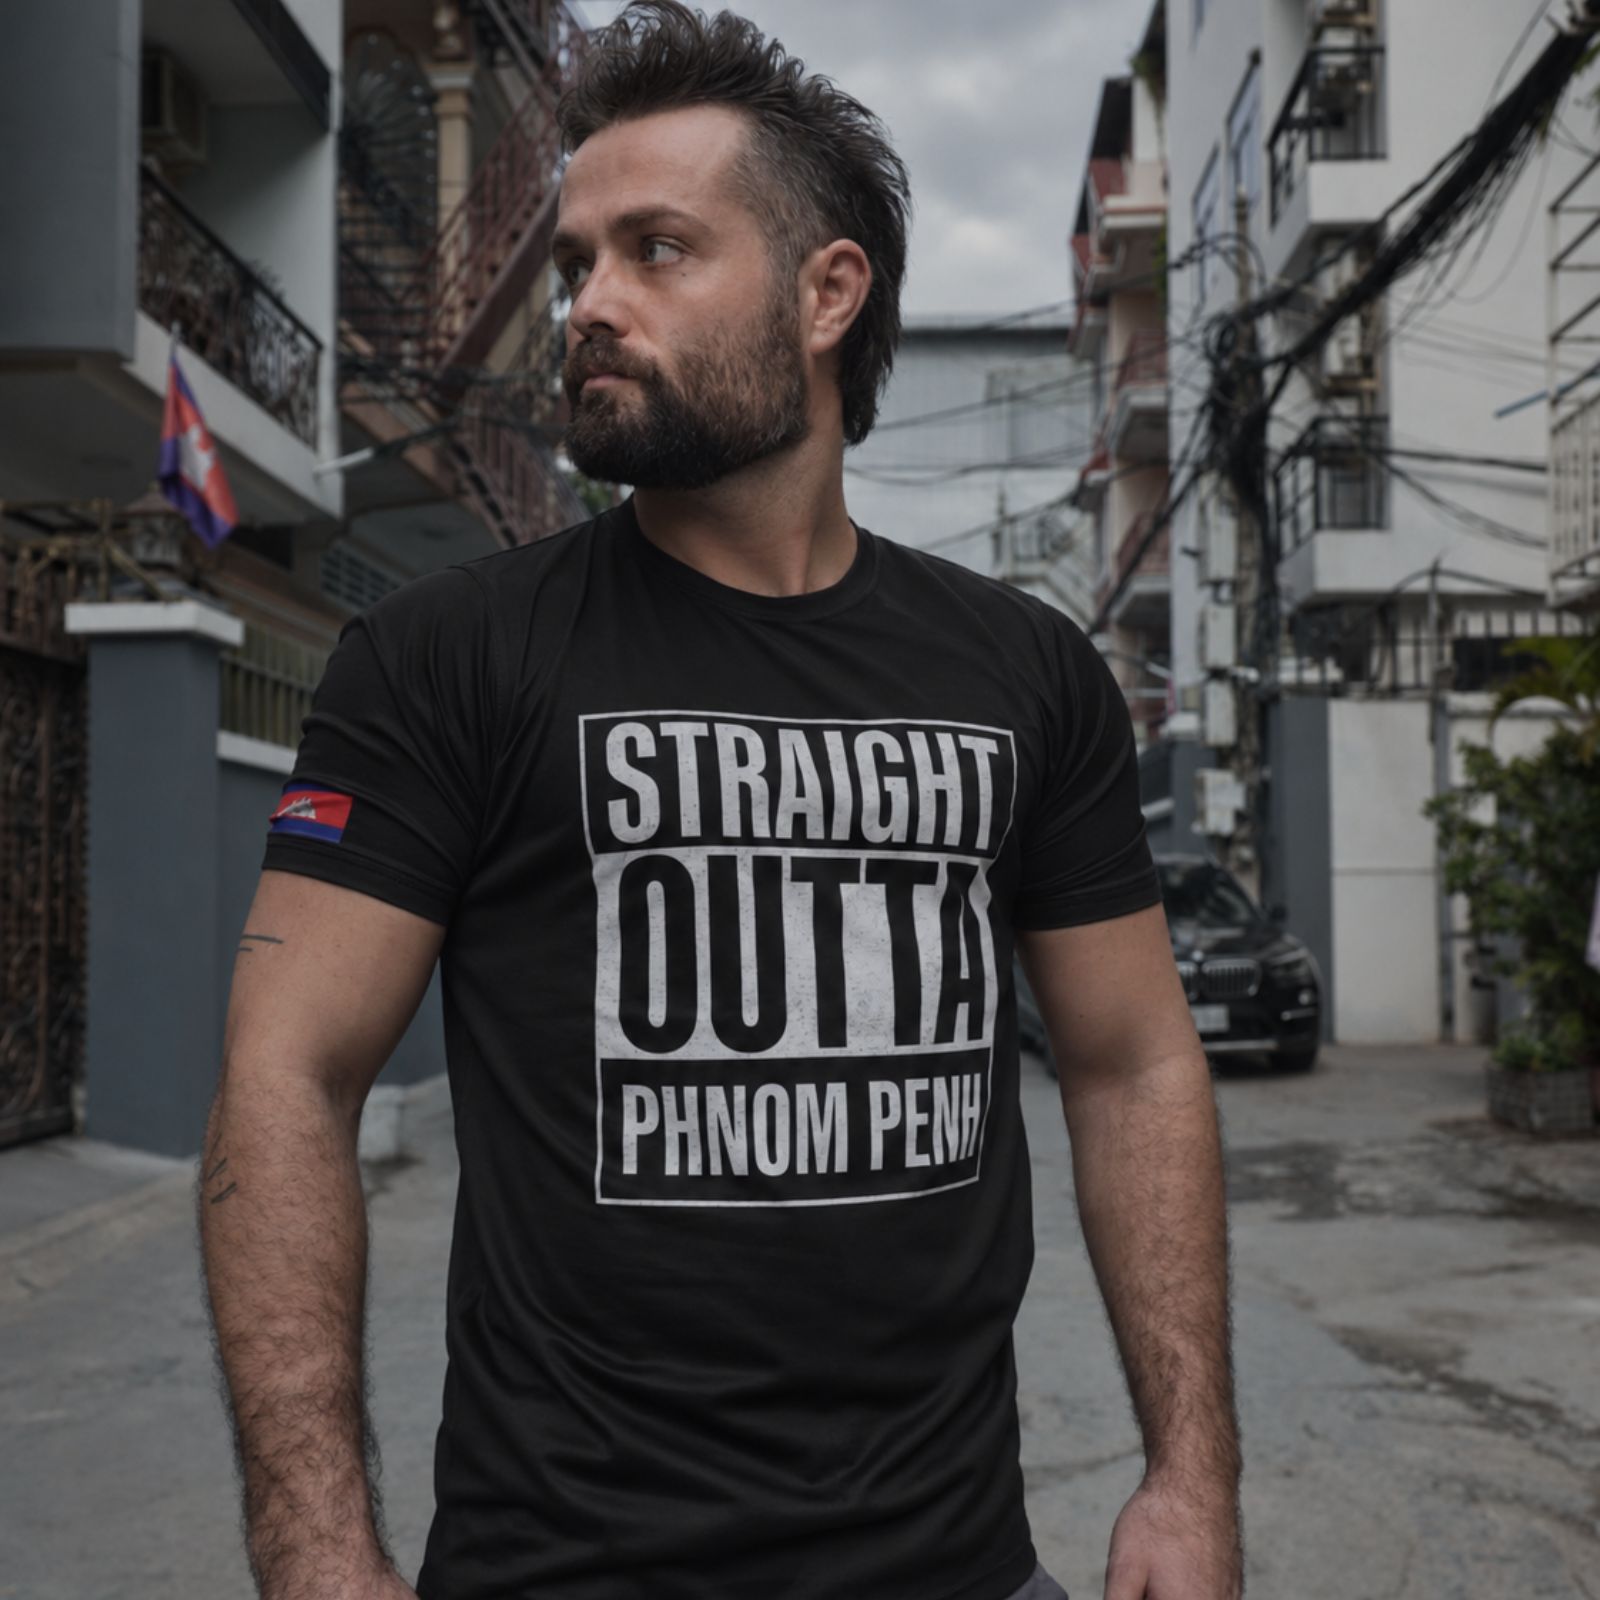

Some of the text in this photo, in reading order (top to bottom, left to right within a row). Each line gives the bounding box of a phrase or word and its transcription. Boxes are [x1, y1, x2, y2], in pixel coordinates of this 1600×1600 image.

[605, 721, 999, 850] STRAIGHT
[617, 853, 985, 1054] OUTTA
[621, 1072, 982, 1176] PHNOM PENH
